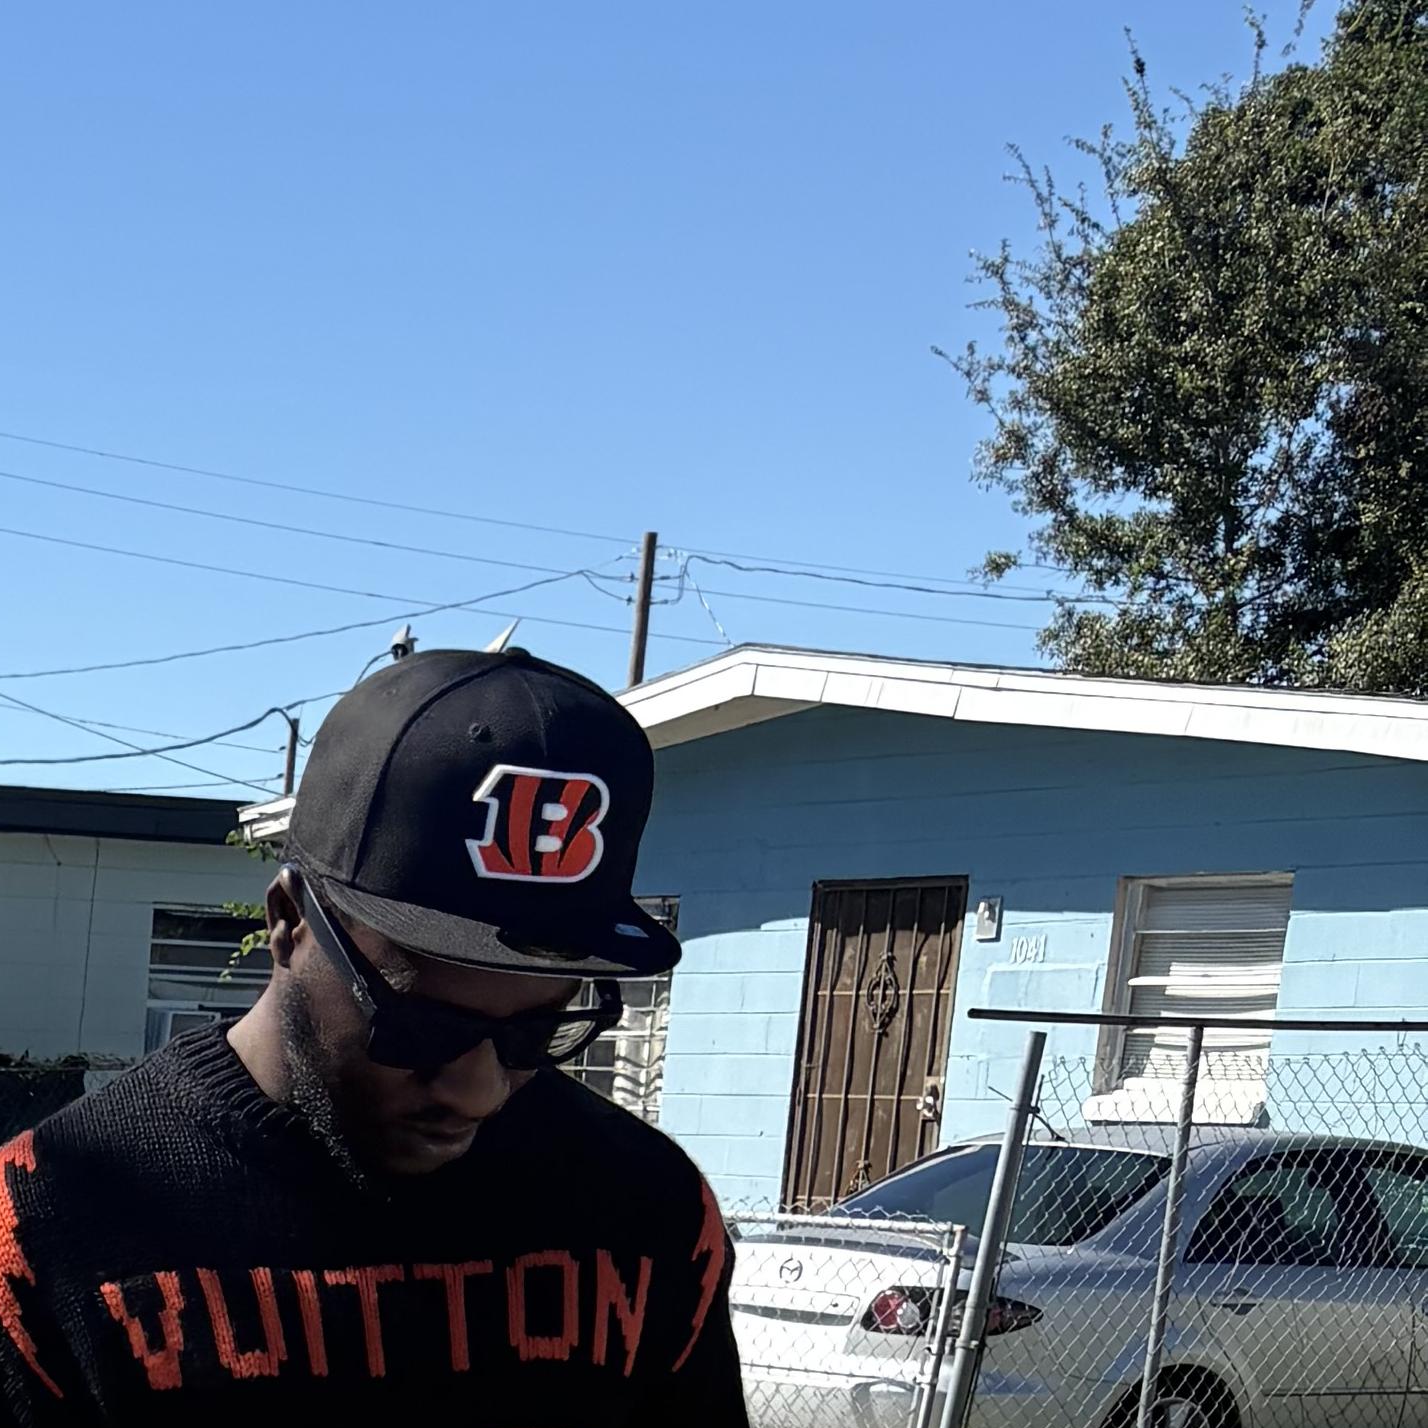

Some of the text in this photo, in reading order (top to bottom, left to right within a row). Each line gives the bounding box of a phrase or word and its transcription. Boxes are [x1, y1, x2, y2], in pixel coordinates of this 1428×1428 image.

[465, 764, 610, 883] B
[1009, 934, 1047, 963] 1041
[100, 1249, 653, 1390] VUITTON
